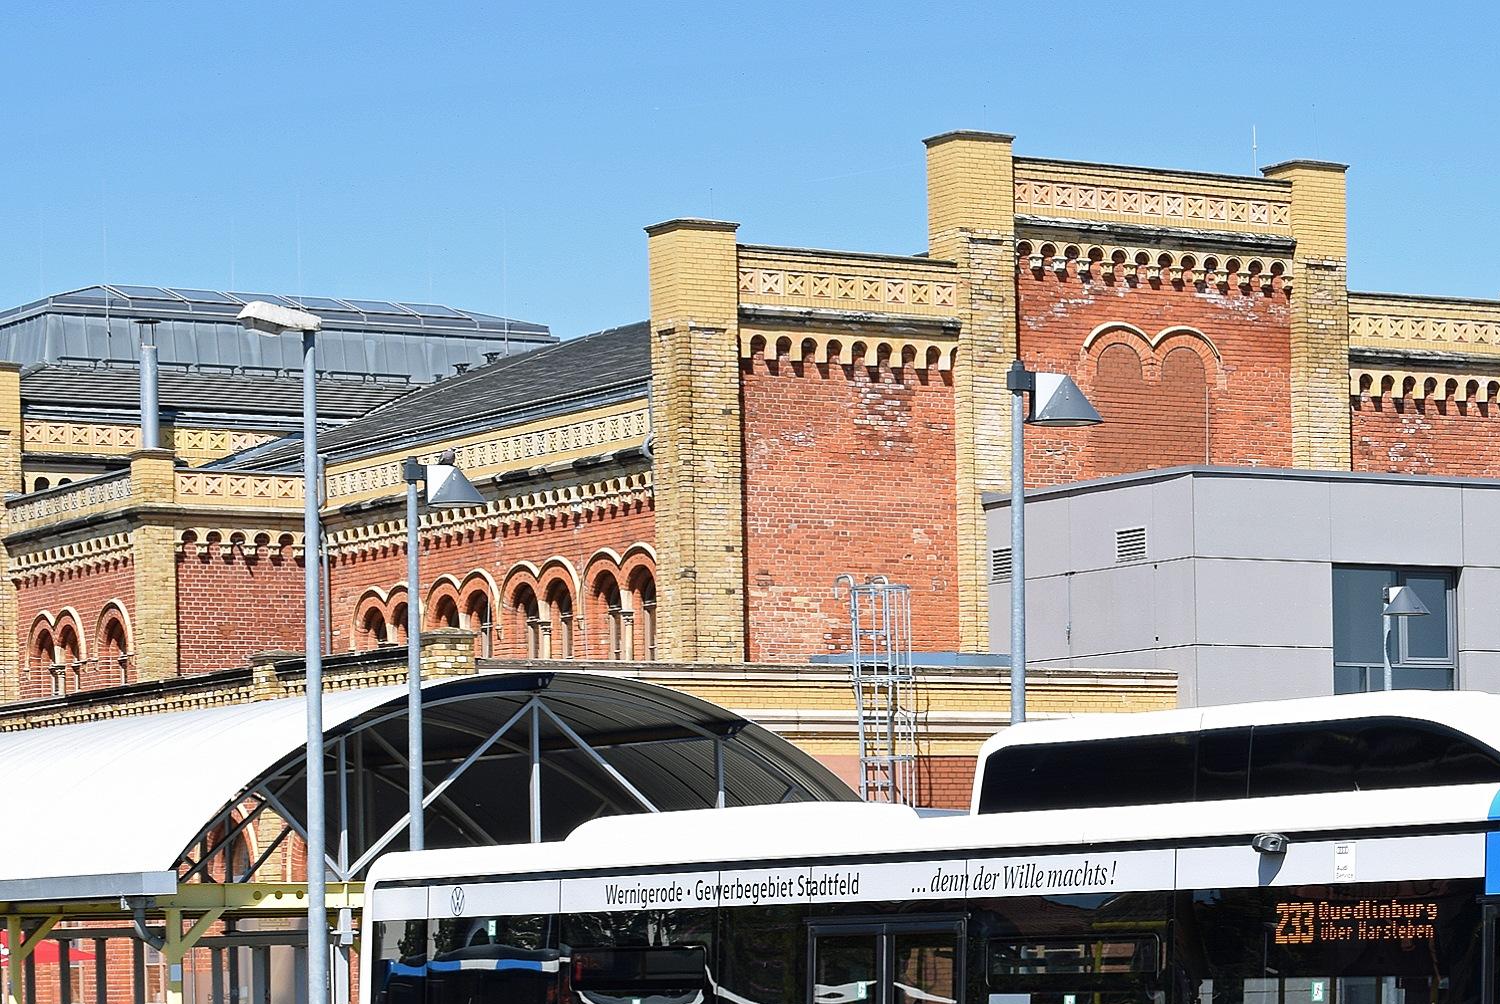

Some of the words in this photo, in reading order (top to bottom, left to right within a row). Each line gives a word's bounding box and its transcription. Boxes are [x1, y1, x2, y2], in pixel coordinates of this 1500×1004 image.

[604, 880, 683, 909] Wernigerode
[694, 874, 794, 905] Gewerbegebiet
[797, 872, 860, 897] Stadtfeld
[972, 866, 1000, 890] der
[1003, 863, 1044, 889] Wille
[1275, 902, 1315, 944] 233
[1318, 899, 1438, 920] Quedlinburg
[1320, 920, 1353, 941] über
[1358, 919, 1435, 940] Harsleben
